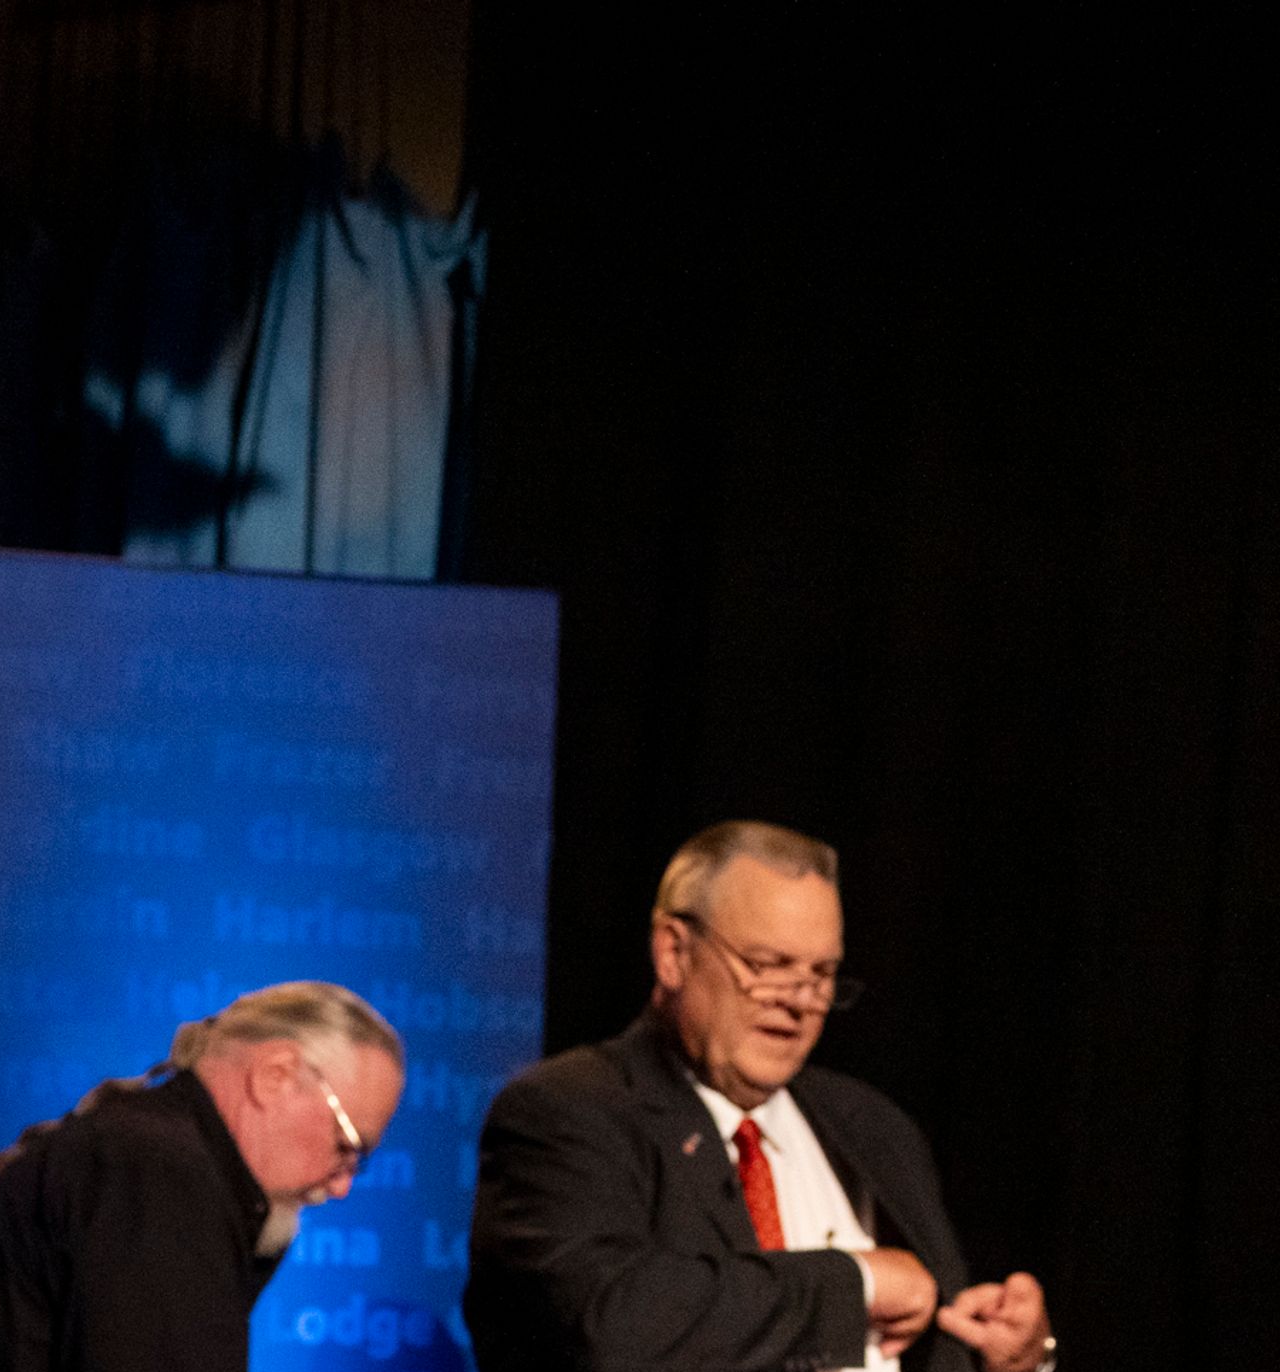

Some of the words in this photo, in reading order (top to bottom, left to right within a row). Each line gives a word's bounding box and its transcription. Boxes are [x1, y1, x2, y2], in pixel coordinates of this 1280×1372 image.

[247, 811, 493, 882] Glasgow
[214, 891, 423, 951] Harlem
[409, 1059, 488, 1127] Hy
